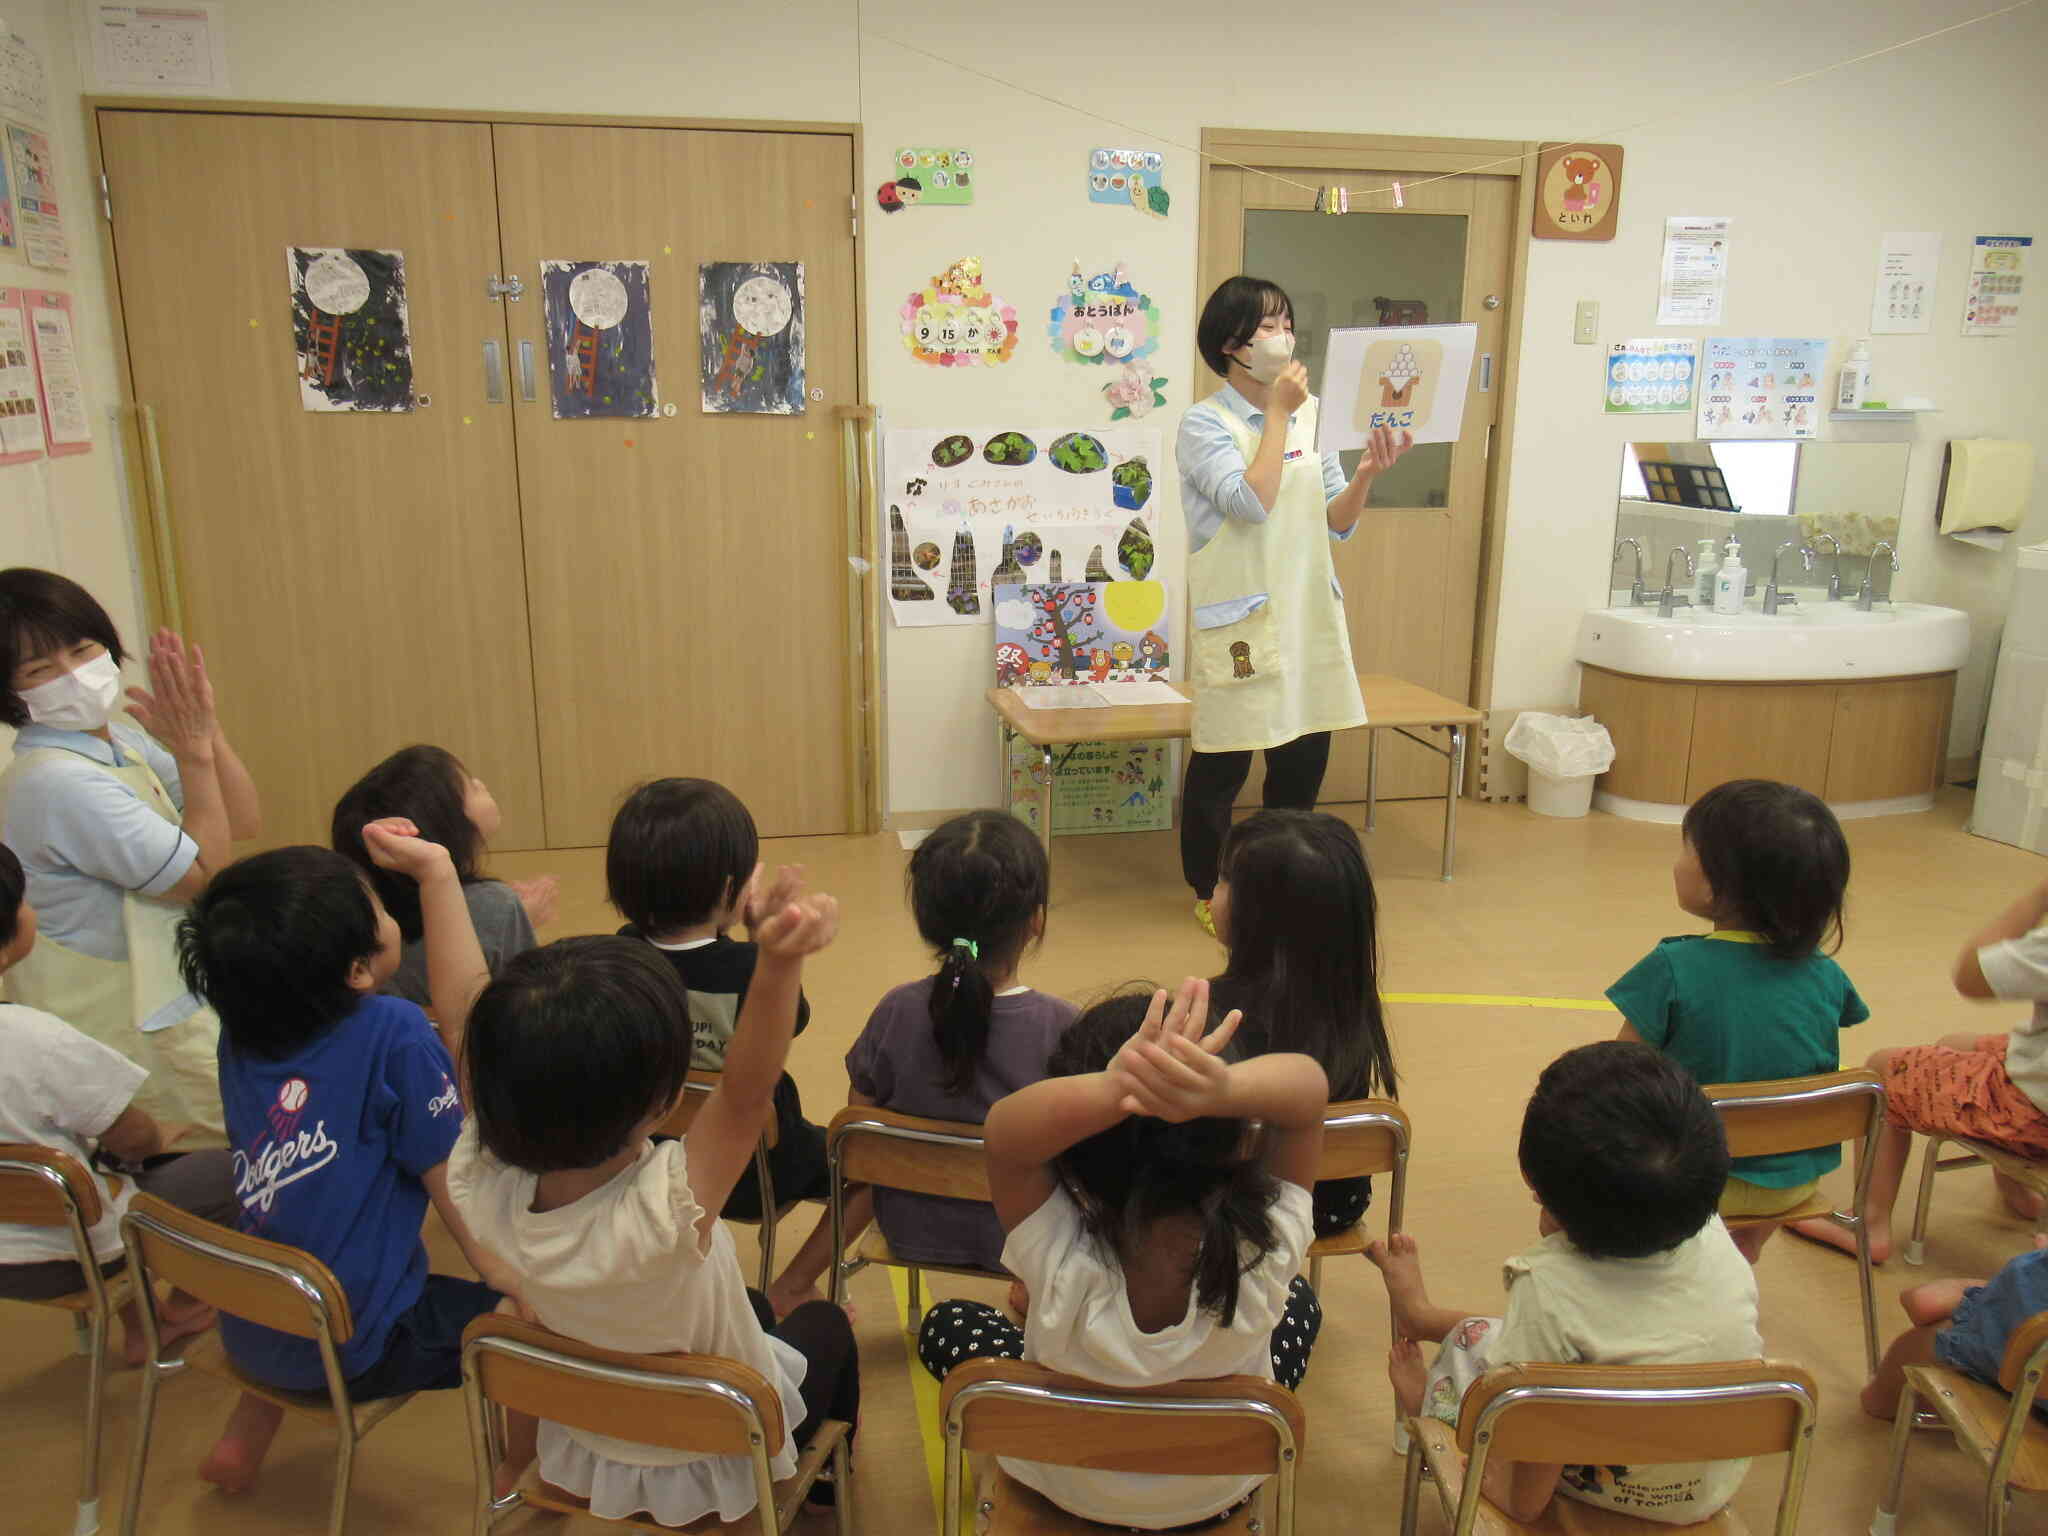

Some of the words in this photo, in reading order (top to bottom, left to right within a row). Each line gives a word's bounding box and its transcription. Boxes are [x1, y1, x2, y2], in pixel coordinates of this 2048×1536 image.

[1558, 212, 1593, 224] といれ
[1073, 304, 1135, 318] おとうばん
[920, 327, 930, 340] 9
[942, 329, 955, 340] 15
[967, 327, 979, 338] か
[1369, 410, 1415, 429] だんご
[233, 1119, 338, 1213] Dodgers
